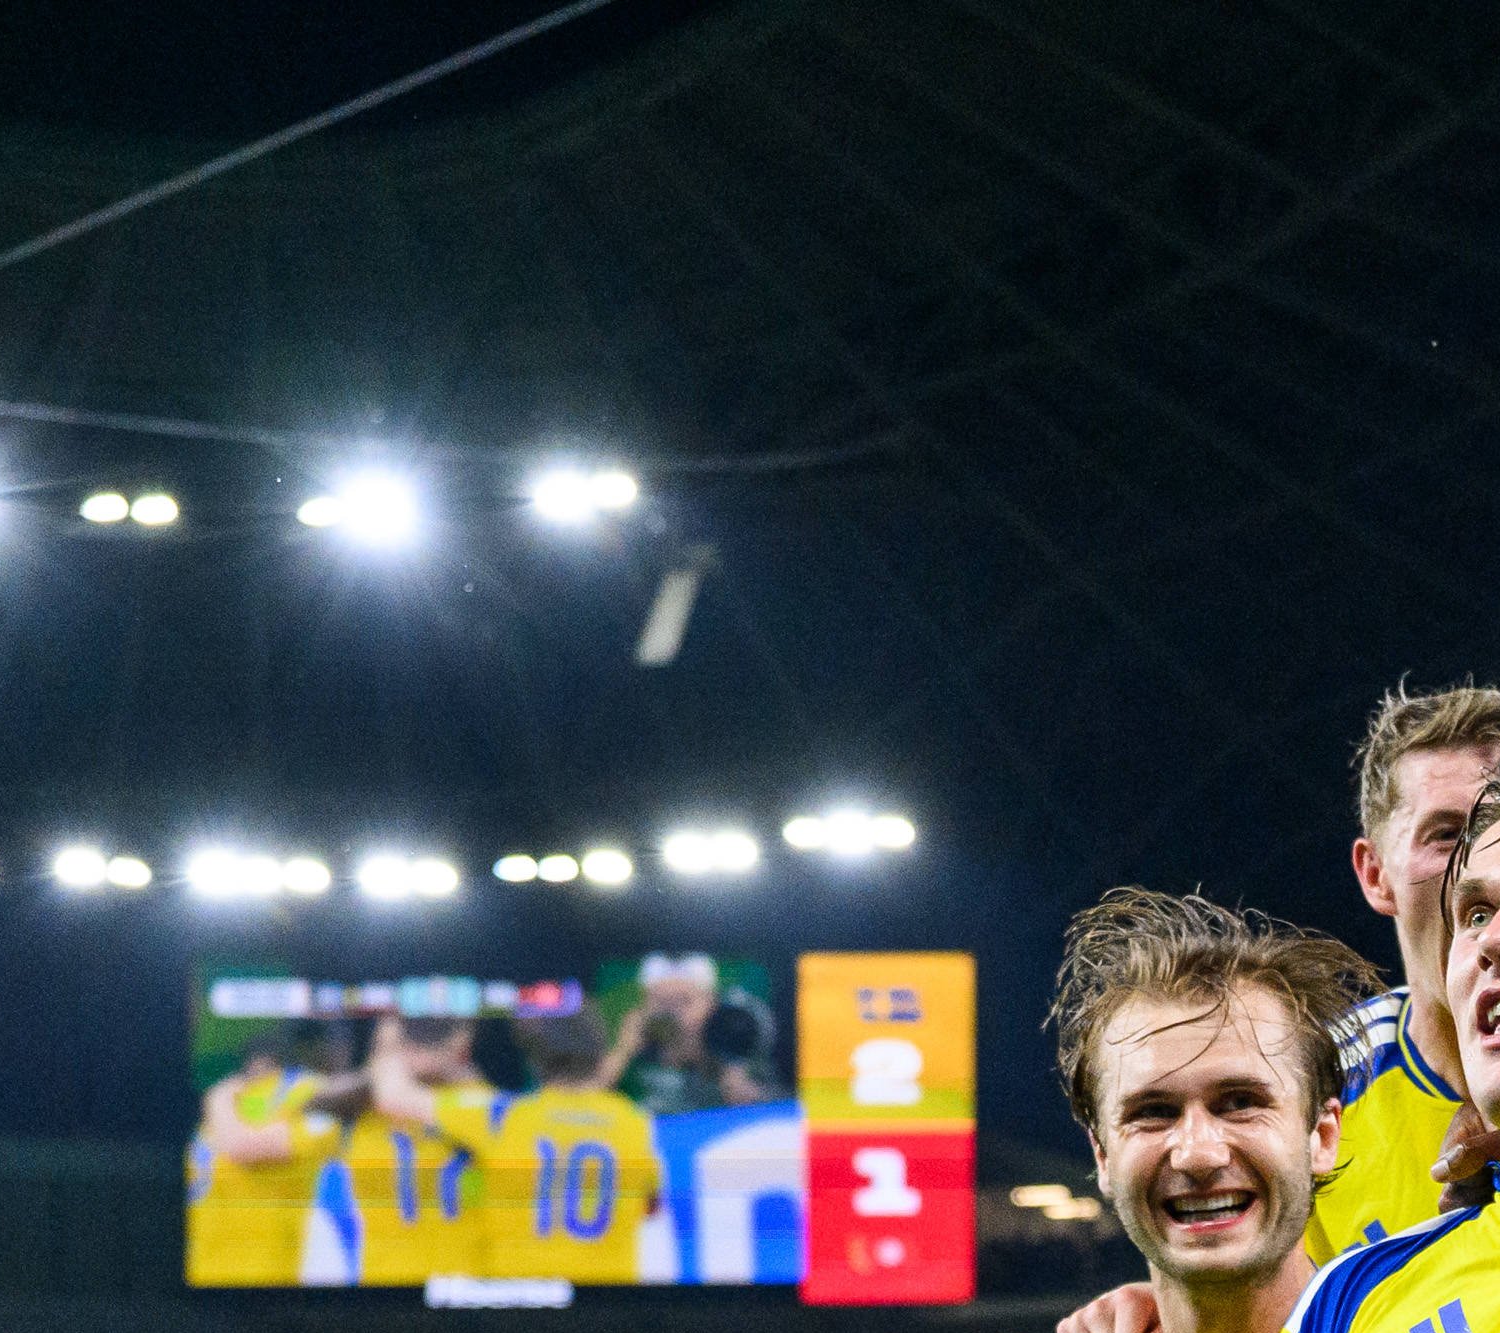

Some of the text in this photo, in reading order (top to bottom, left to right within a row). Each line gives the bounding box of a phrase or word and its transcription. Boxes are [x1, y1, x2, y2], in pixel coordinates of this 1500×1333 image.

[852, 1039, 924, 1106] 2
[535, 1137, 618, 1241] 10
[852, 1147, 923, 1217] 1
